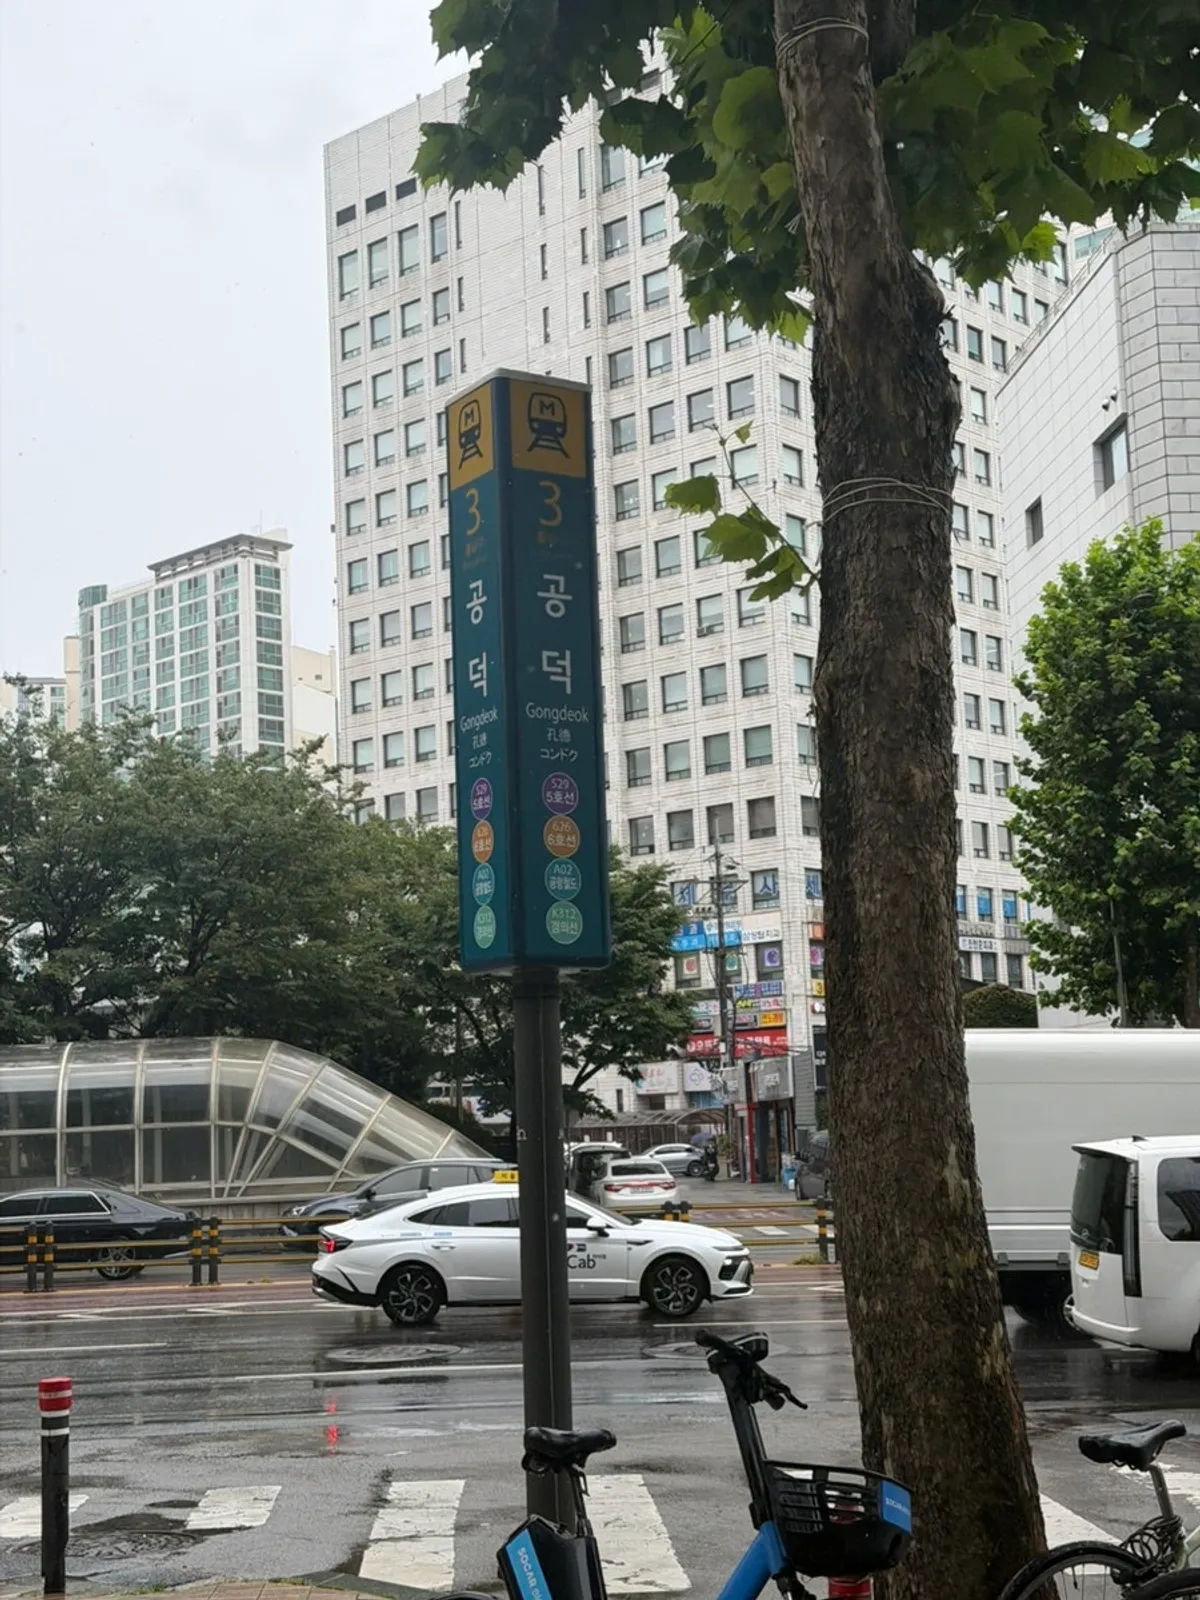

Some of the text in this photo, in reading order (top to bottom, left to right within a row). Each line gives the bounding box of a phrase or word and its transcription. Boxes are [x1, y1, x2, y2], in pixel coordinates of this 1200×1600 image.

[465, 488, 481, 536] 3
[538, 480, 562, 527] 3
[460, 705, 499, 733] Gongdeok
[526, 702, 590, 724] Gongdeok
[540, 748, 578, 762] コンドク
[553, 863, 574, 875] A02
[567, 1253, 596, 1269] Cab
[517, 1547, 537, 1588] SOCAR
